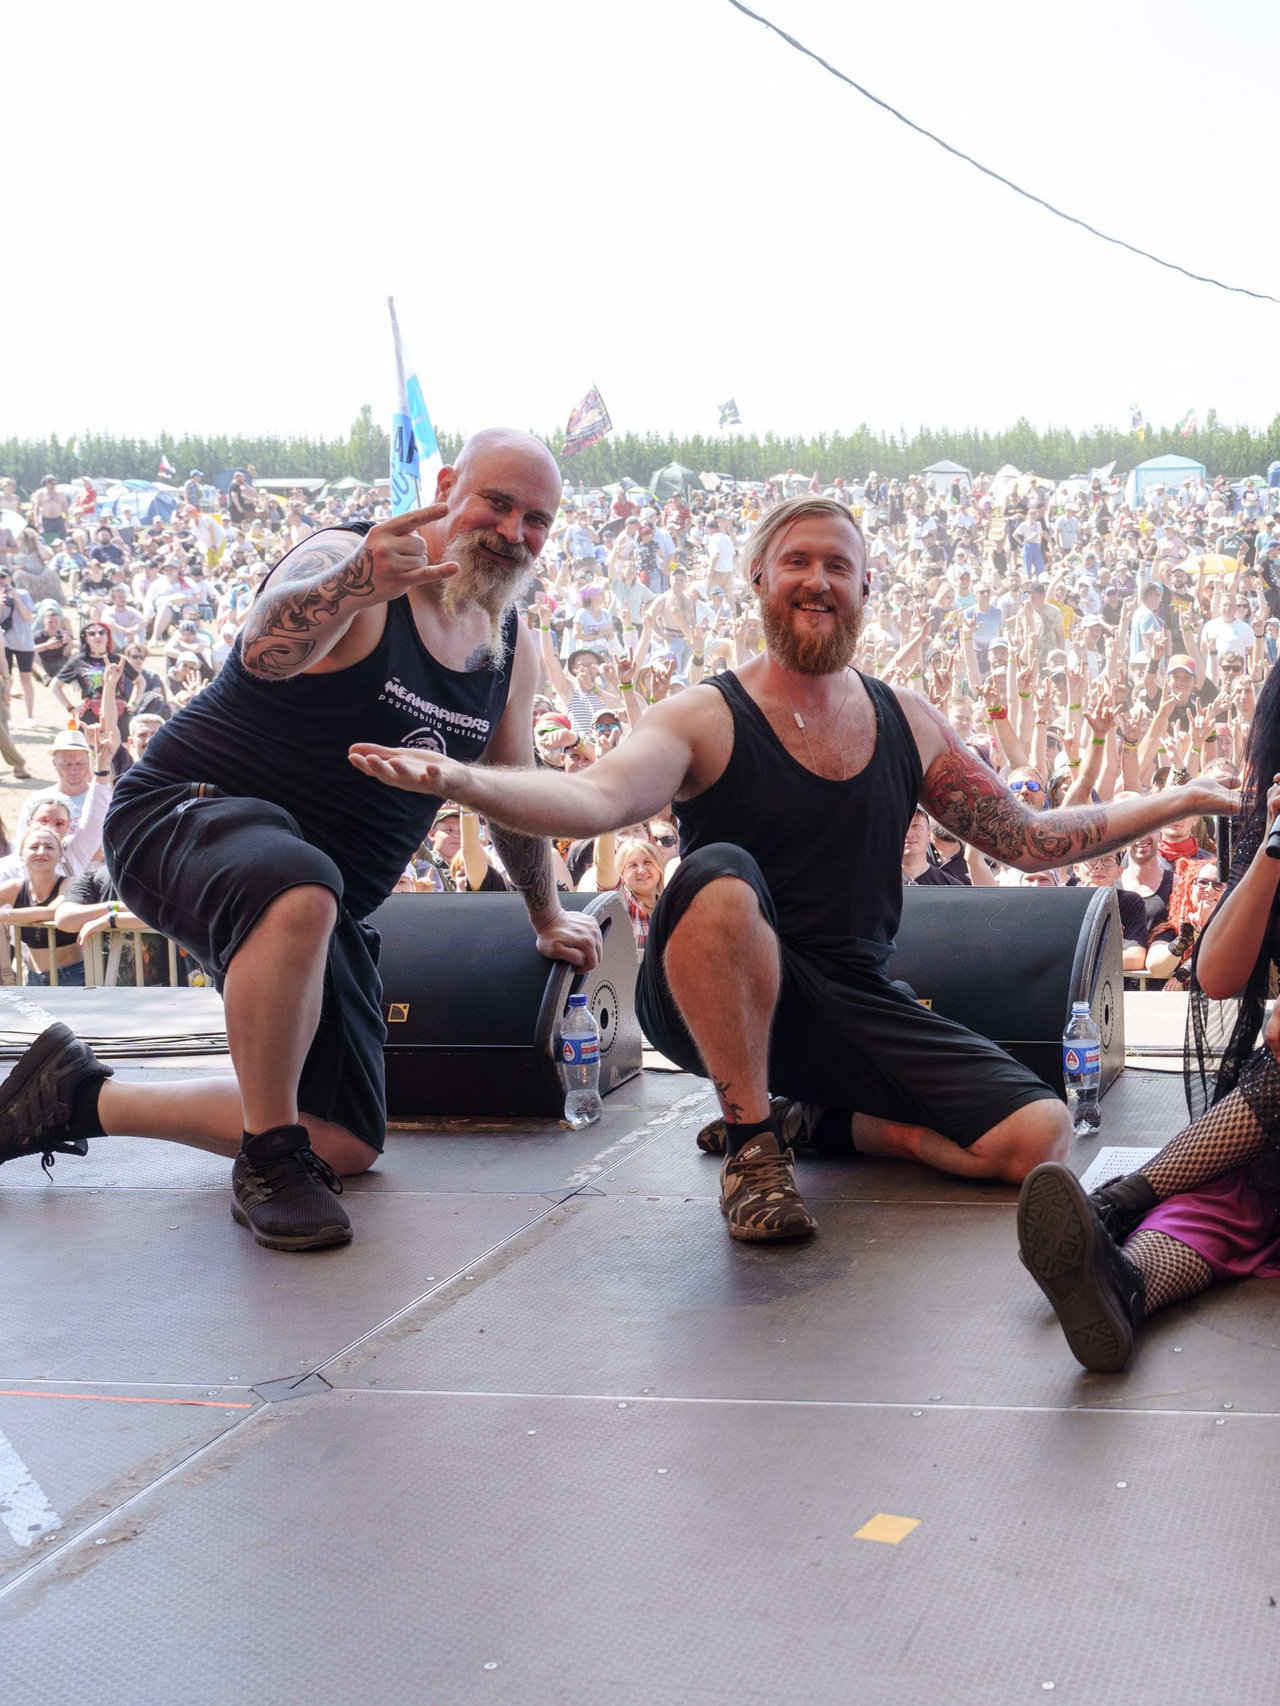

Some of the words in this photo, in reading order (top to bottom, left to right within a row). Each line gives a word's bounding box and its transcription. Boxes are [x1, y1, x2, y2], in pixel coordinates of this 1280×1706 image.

[378, 694, 443, 729] psychobilly
[446, 725, 487, 742] outlaws
[384, 679, 490, 733] MEANTRAITORS
